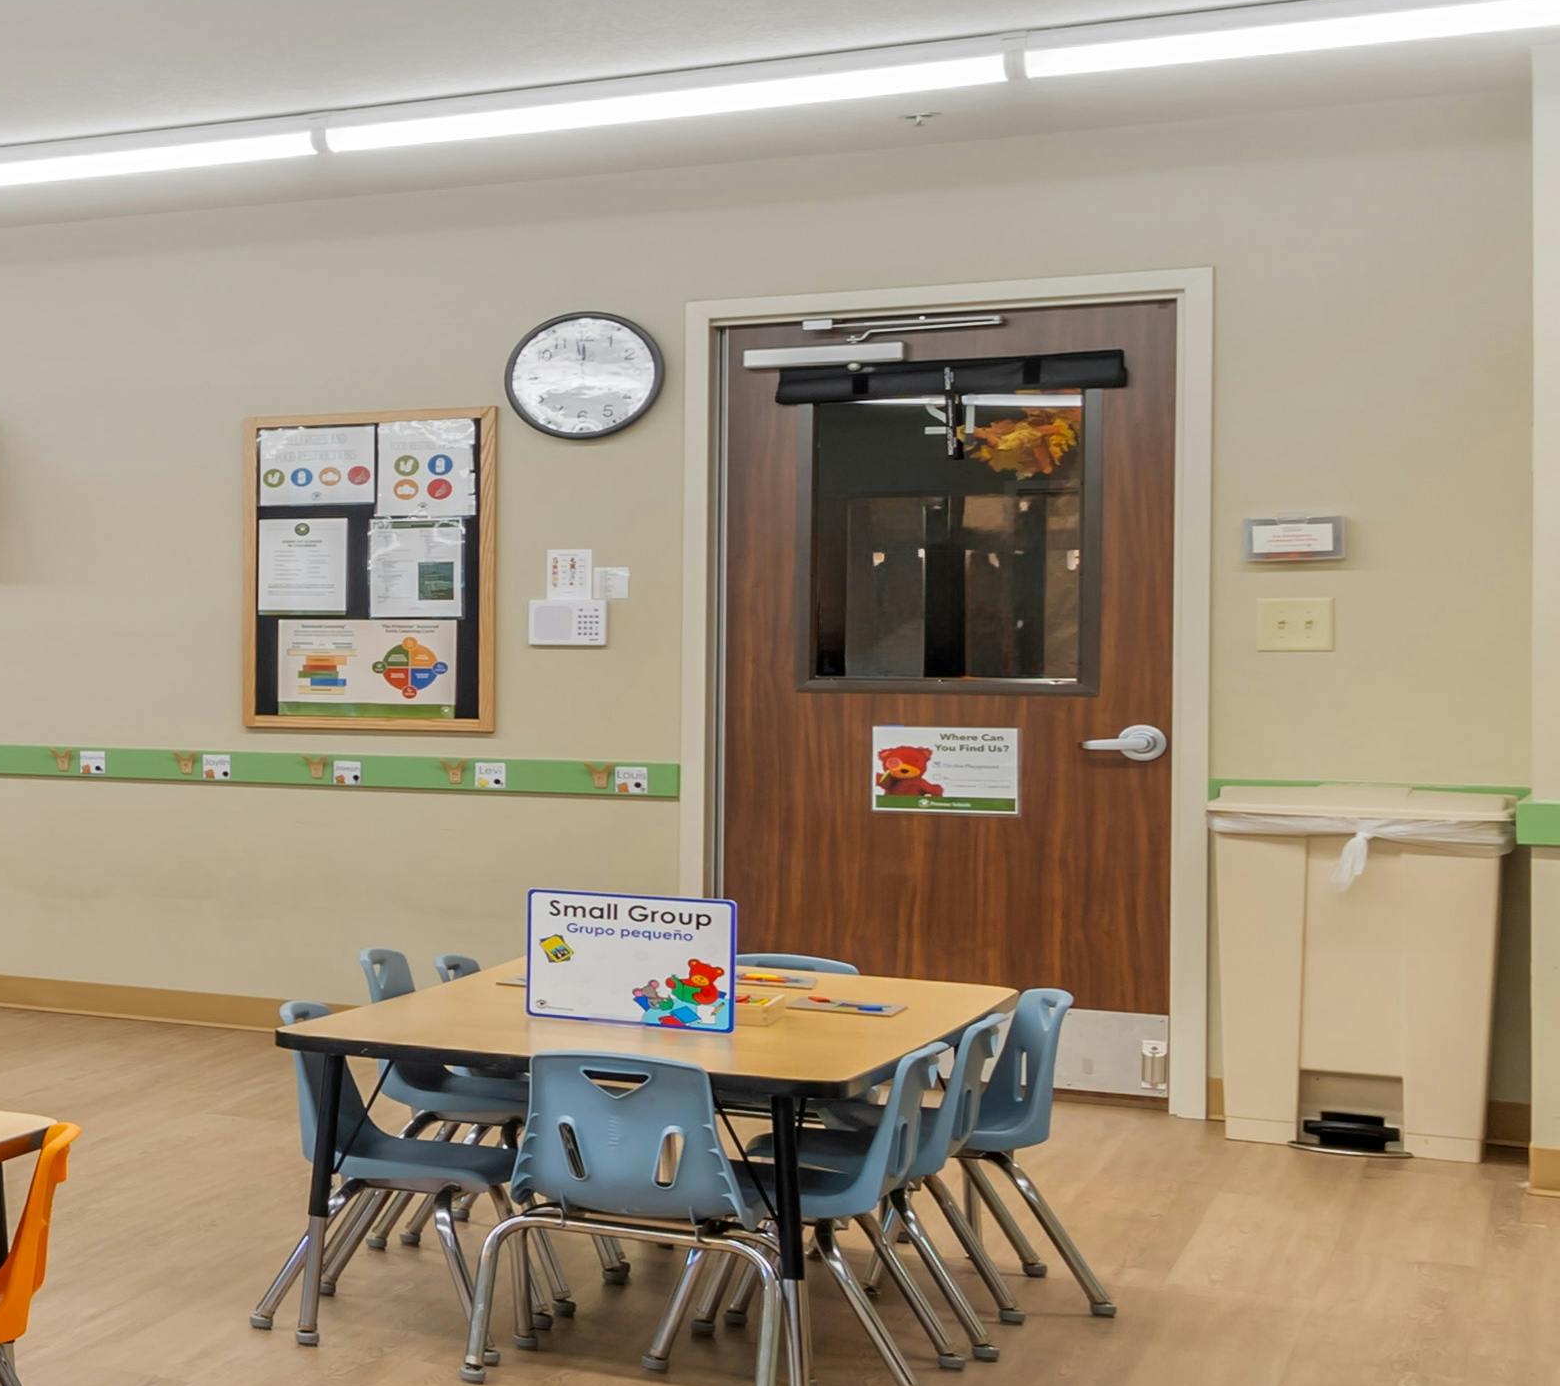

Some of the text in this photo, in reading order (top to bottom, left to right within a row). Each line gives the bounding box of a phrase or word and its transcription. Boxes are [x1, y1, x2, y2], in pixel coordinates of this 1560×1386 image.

[602, 404, 614, 418] 5
[939, 733, 1005, 742] Where Can
[934, 744, 1010, 753] You Find Us?
[549, 899, 712, 930] Small Group
[566, 923, 694, 942] Grupo pequeño
